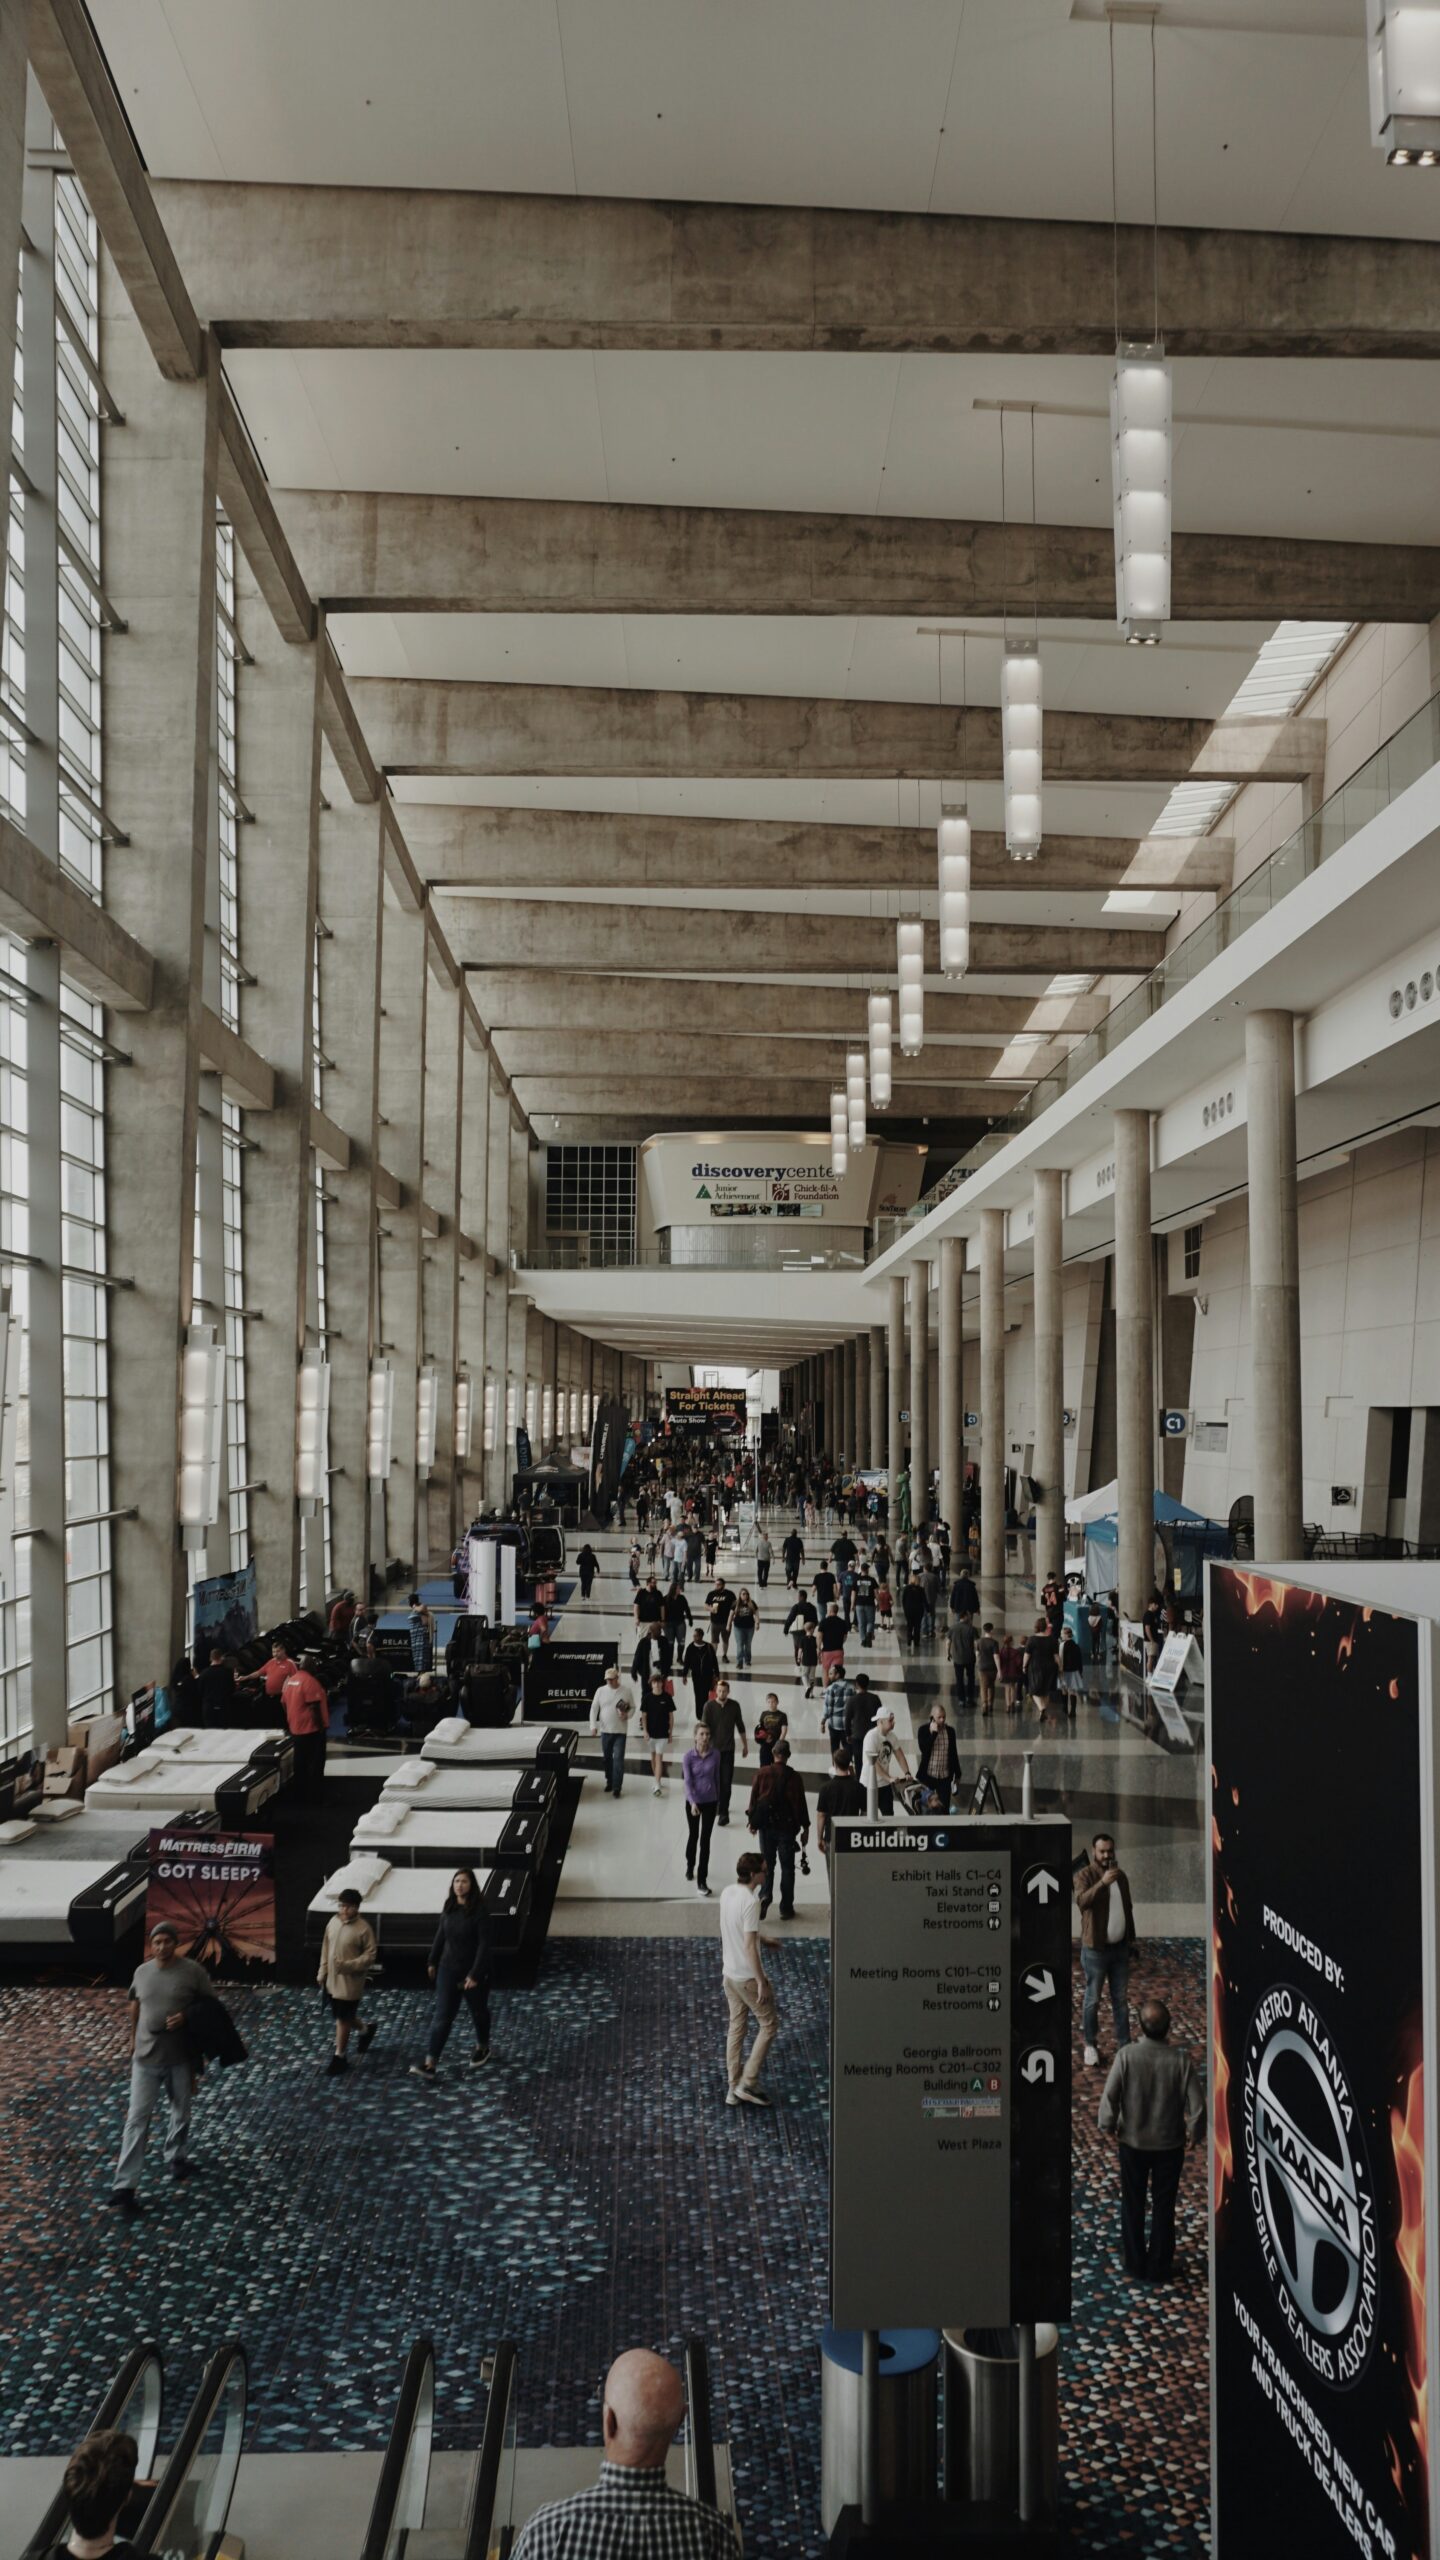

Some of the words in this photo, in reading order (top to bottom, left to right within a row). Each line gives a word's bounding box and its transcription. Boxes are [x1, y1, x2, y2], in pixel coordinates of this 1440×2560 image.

[692, 1163, 836, 1181] discoverycente
[715, 1184, 738, 1192] Junior
[794, 1184, 838, 1192] Chick-fil-A
[715, 1192, 760, 1200] Achievement
[670, 1391, 710, 1401] Straight
[713, 1391, 744, 1400] Ahead
[679, 1402, 696, 1410] For
[698, 1402, 736, 1410] Tickets
[668, 1414, 687, 1423] Auto
[1166, 1418, 1181, 1429] C1
[547, 1689, 587, 1697] RELIEVE
[850, 1831, 928, 1851] Building
[935, 1833, 945, 1847] C
[158, 1863, 196, 1879] GOT
[200, 1865, 261, 1881] SLEEP?
[891, 1870, 932, 1881] Exhibit
[935, 1870, 961, 1880] Halls
[926, 1886, 948, 1897] Taxi
[952, 1885, 984, 1896] Stand
[937, 1902, 984, 1913] Elevator
[923, 1918, 984, 1929] Restrooms
[1262, 1903, 1323, 1972] PRODUCED
[1324, 1954, 1345, 1993] BY:
[850, 1967, 898, 1981] Meeting
[902, 1967, 940, 1978] Rooms
[937, 1983, 983, 1994] Elevator
[922, 1999, 984, 2010] Restrooms
[903, 2046, 948, 2060] Georgia
[951, 2046, 1002, 2057] Ballroom
[1255, 1989, 1293, 2042] METRO
[1297, 2000, 1354, 2133] ATLANTA
[844, 2064, 892, 2078] Meeting
[896, 2063, 935, 2074] Rooms
[923, 2079, 968, 2093] Building
[972, 2079, 983, 2090] A
[990, 2079, 999, 2090] B
[937, 2139, 967, 2150] West
[972, 2138, 1002, 2150] Plaza
[1262, 2107, 1352, 2243] MAADA
[1244, 2060, 1278, 2282] AUTOMOBILE
[1278, 2283, 1335, 2381] DEALERS
[1338, 2191, 1376, 2381] ASSOCIATION
[1232, 2290, 1261, 2350] YOUR
[1261, 2335, 1331, 2459] FRANCHISED
[1333, 2446, 1363, 2510] NEW
[1365, 2499, 1397, 2560] CAR
[1251, 2354, 1274, 2400] AND
[1274, 2386, 1313, 2466] TRUCK
[1313, 2449, 1373, 2560] DEALERS
